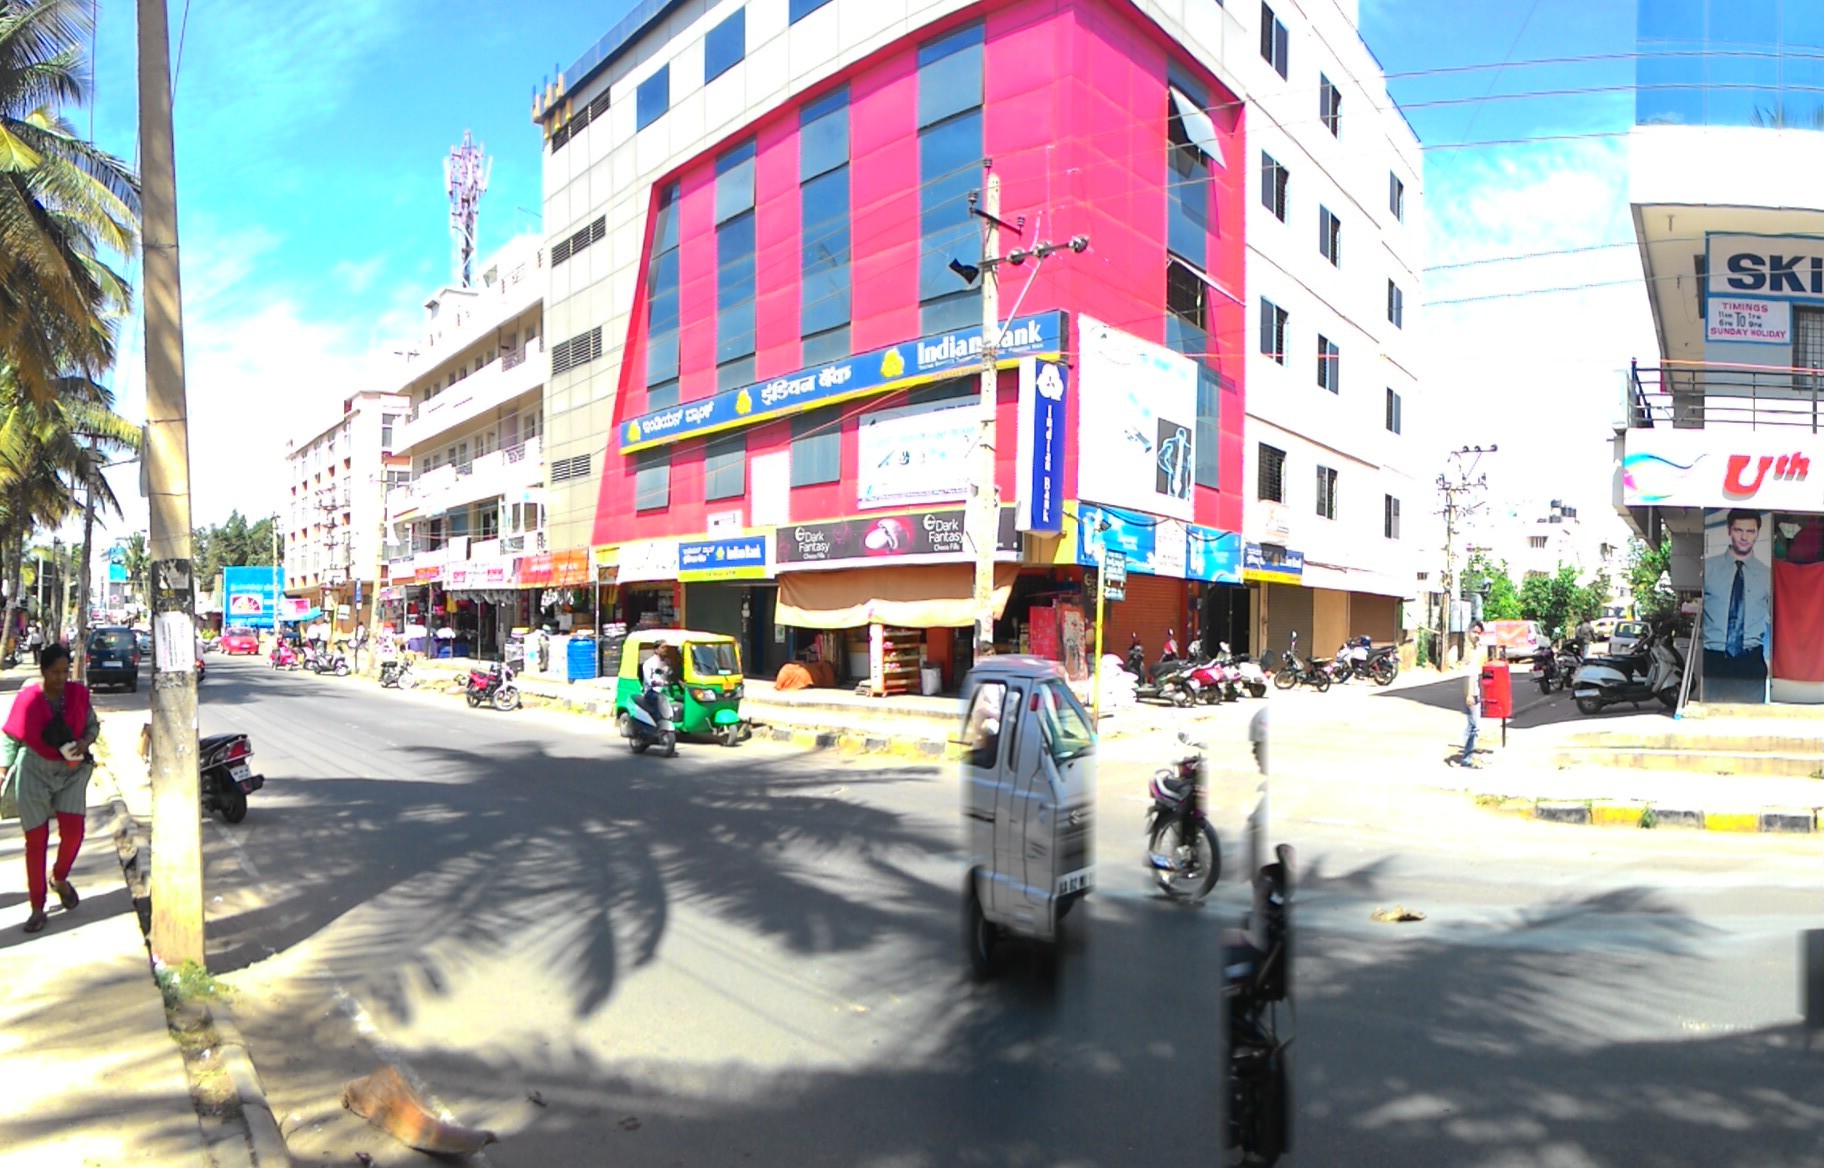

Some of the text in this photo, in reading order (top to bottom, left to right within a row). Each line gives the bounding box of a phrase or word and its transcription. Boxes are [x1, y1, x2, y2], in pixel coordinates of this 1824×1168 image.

[1722, 302, 1768, 313] TIMINGS
[1710, 327, 1786, 338] SUNDAY HOLIDAY
[917, 335, 982, 364] Indian
[1722, 452, 1811, 499] Uth
[935, 517, 959, 532] Dark
[805, 530, 825, 542] Dark
[928, 530, 964, 544] Fantasy
[798, 541, 830, 553] Fantasy
